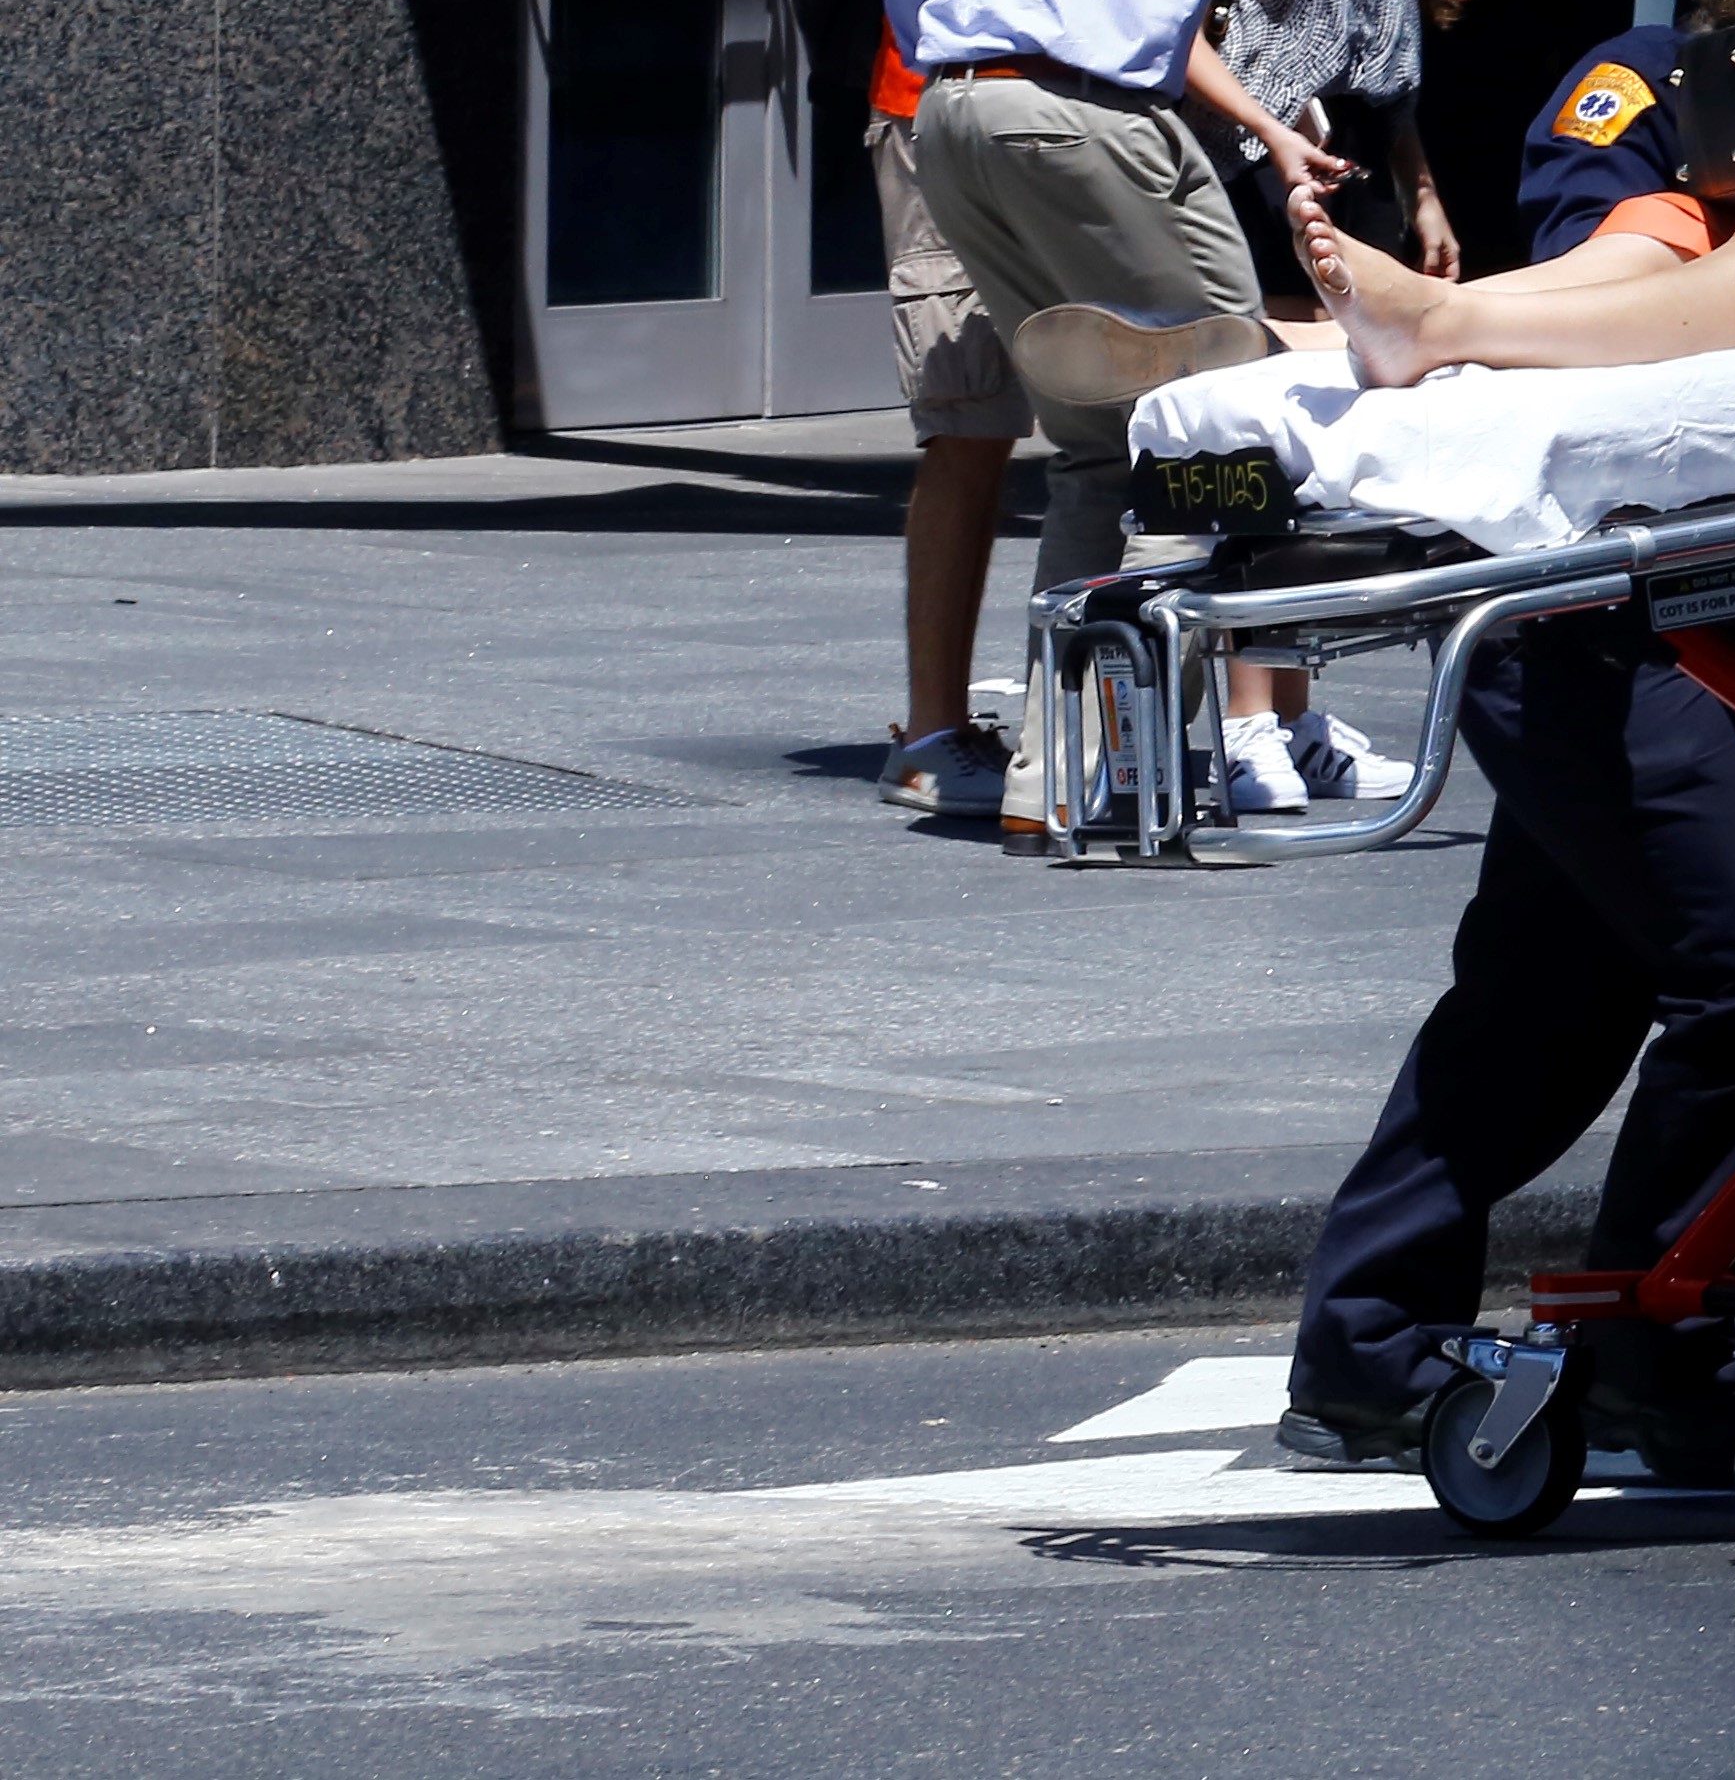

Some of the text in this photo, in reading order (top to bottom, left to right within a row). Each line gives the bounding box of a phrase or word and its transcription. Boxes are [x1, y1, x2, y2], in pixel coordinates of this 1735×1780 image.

[1660, 604, 1685, 618] COT
[1687, 600, 1699, 614] IS
[1701, 595, 1728, 612] FOR
